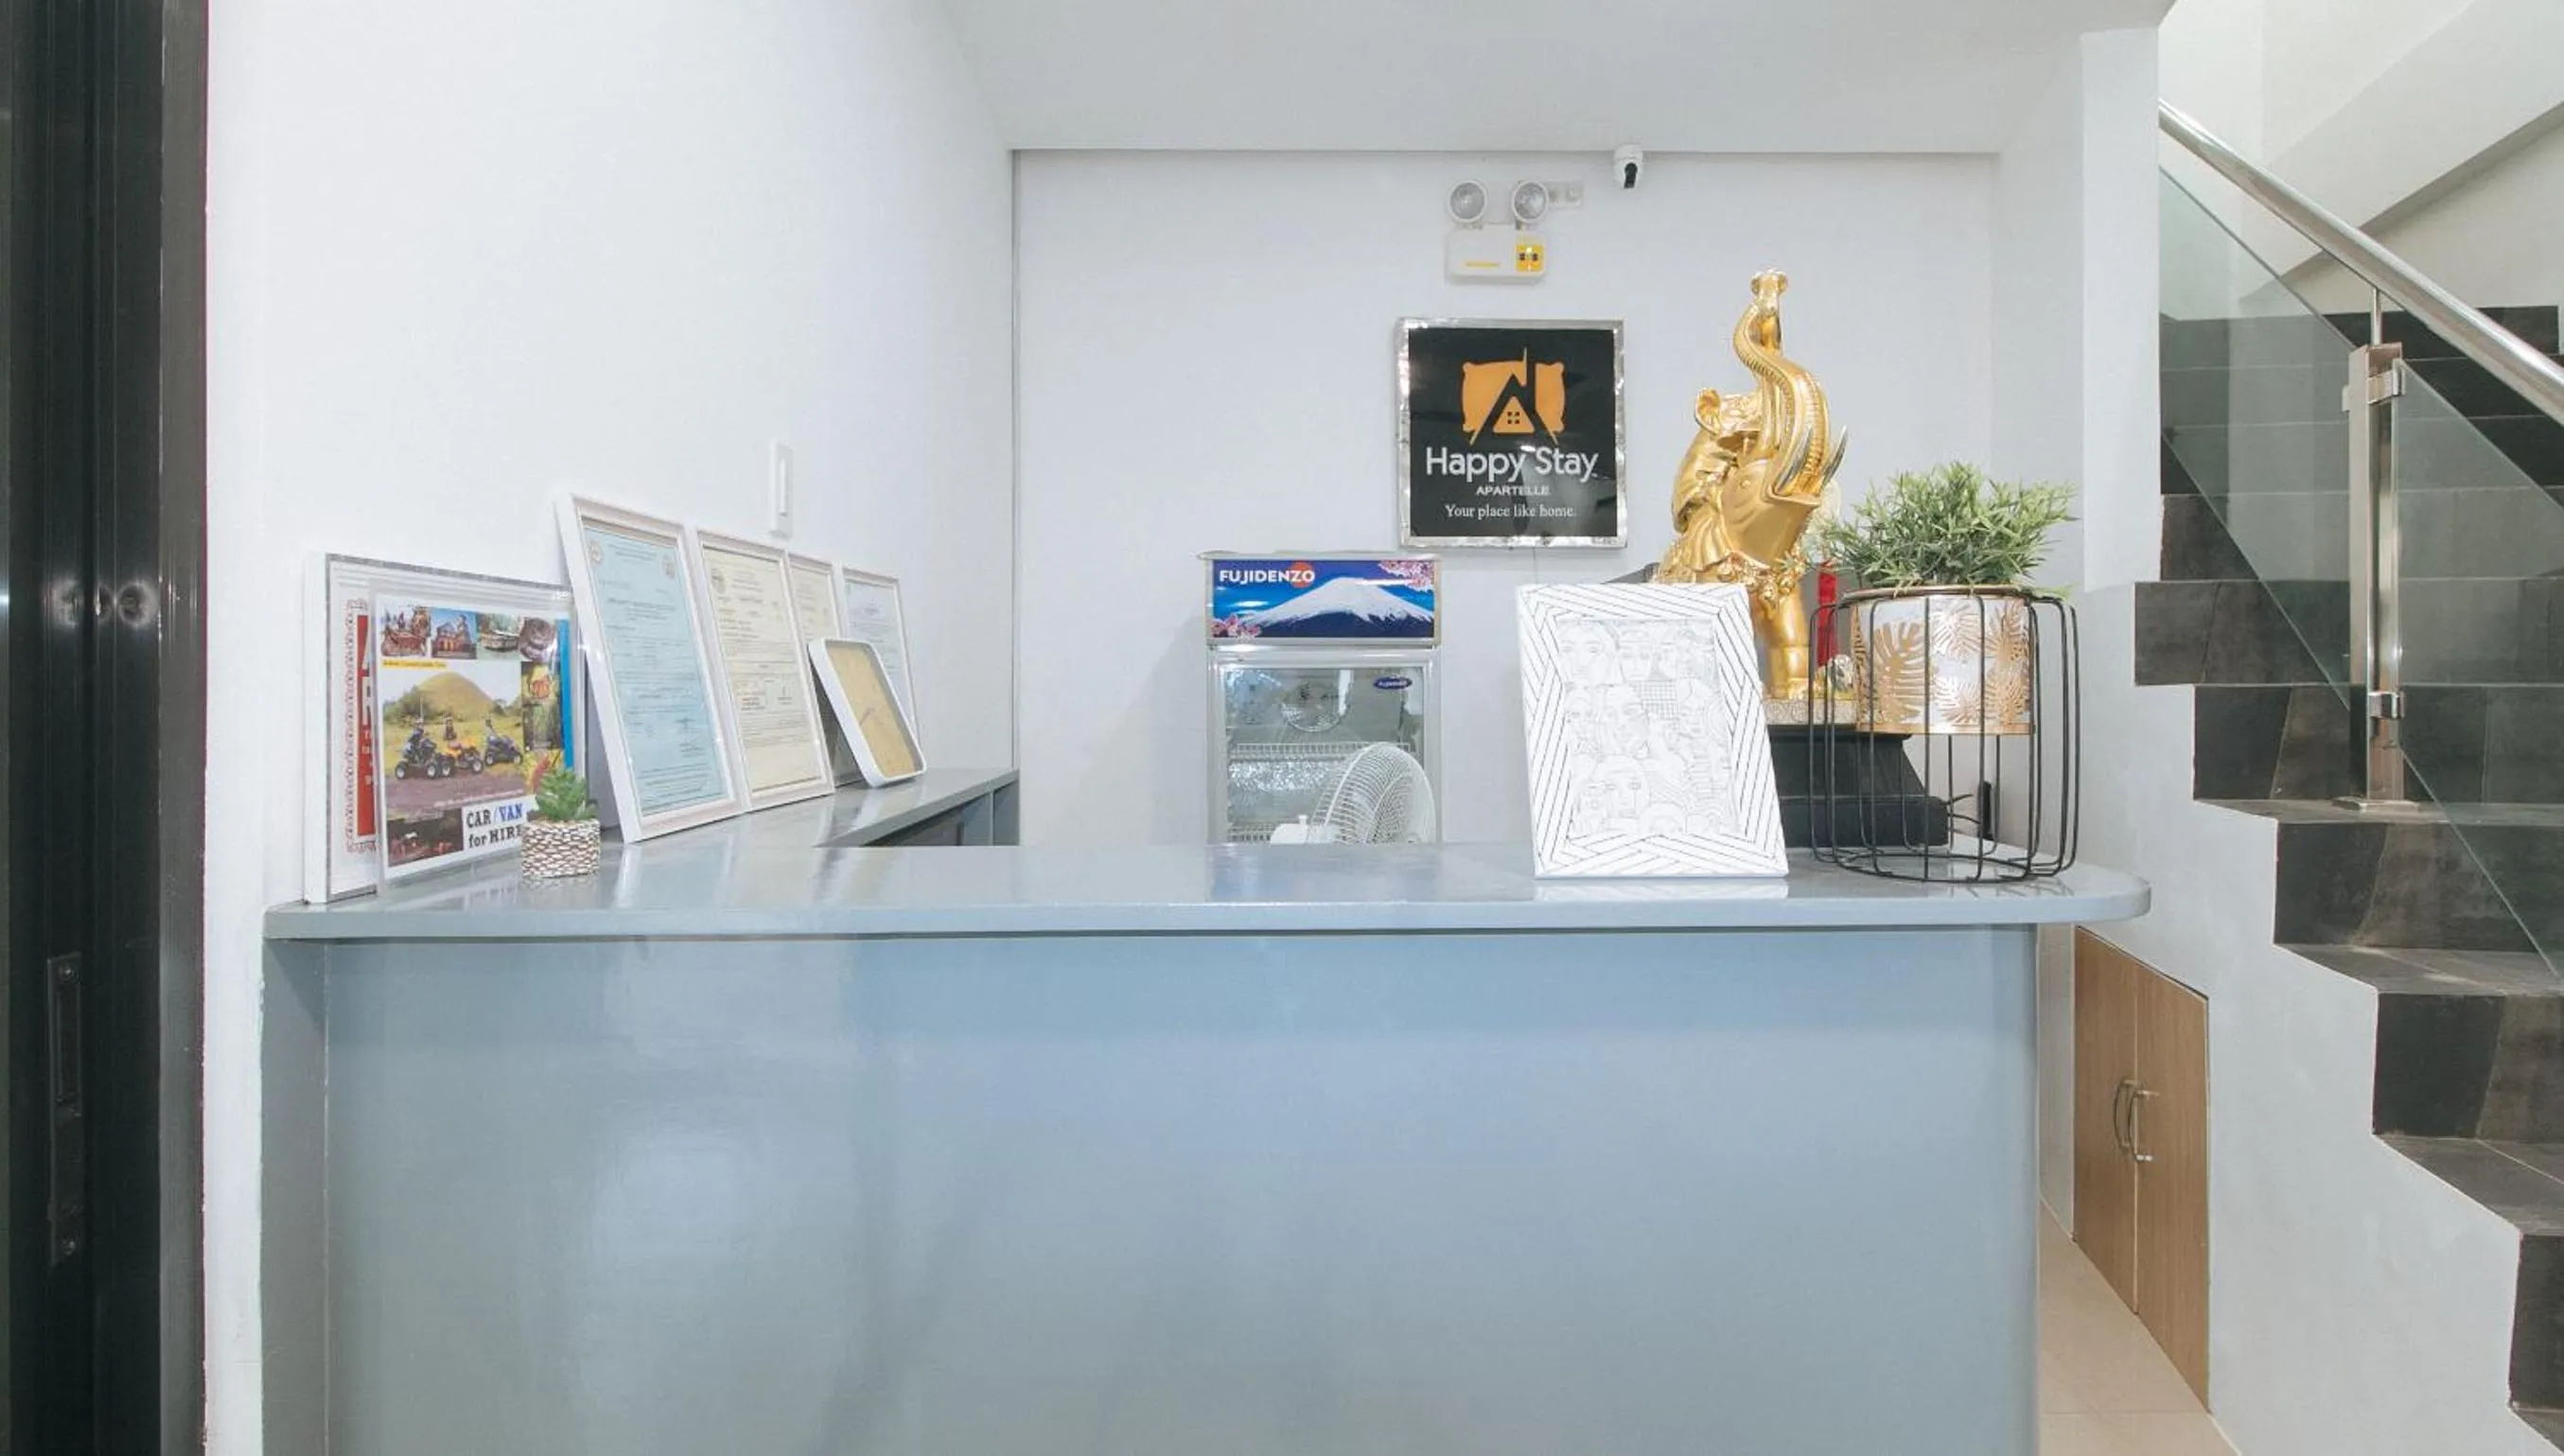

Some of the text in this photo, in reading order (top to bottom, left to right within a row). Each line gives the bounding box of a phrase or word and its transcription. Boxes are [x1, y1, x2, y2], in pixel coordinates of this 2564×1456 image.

[1426, 447, 1599, 482] Happy Stay
[1476, 485, 1550, 497] APARTELLE
[1445, 504, 1474, 517] Your
[1478, 504, 1510, 520] place
[1514, 504, 1536, 517] like
[1220, 570, 1315, 585] FUJIDENZO
[466, 809, 491, 828] CAR
[468, 833, 487, 848] for
